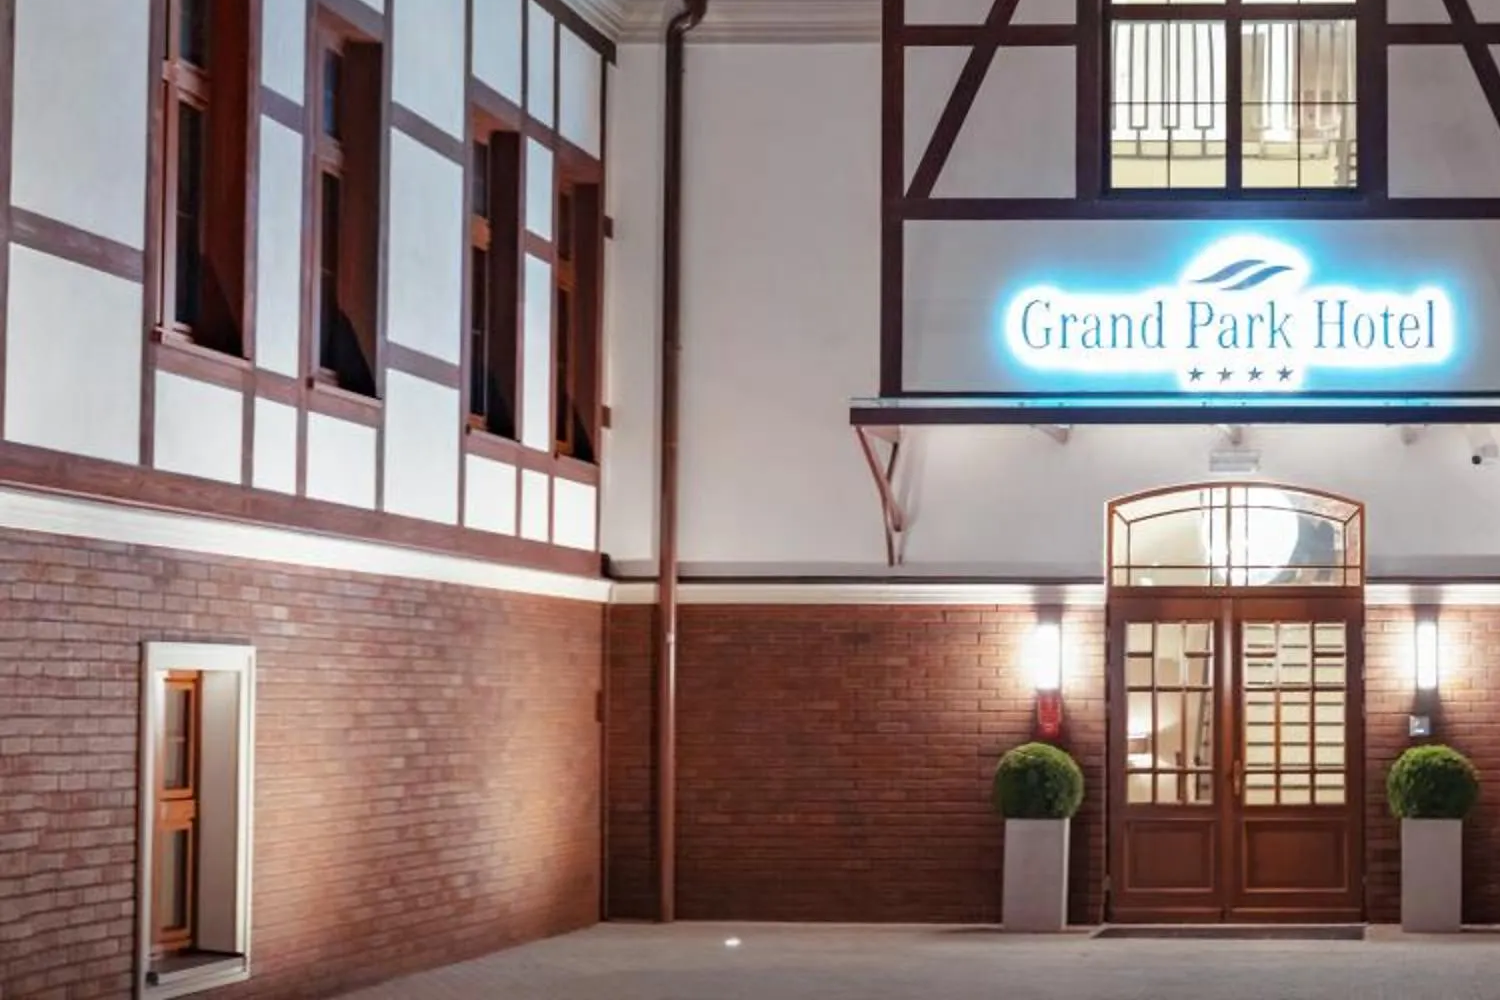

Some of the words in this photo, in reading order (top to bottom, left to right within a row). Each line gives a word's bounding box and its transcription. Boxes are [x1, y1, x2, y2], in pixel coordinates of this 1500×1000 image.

[1021, 299, 1165, 350] Grand
[1185, 300, 1293, 349] Park
[1313, 300, 1436, 349] Hotel
